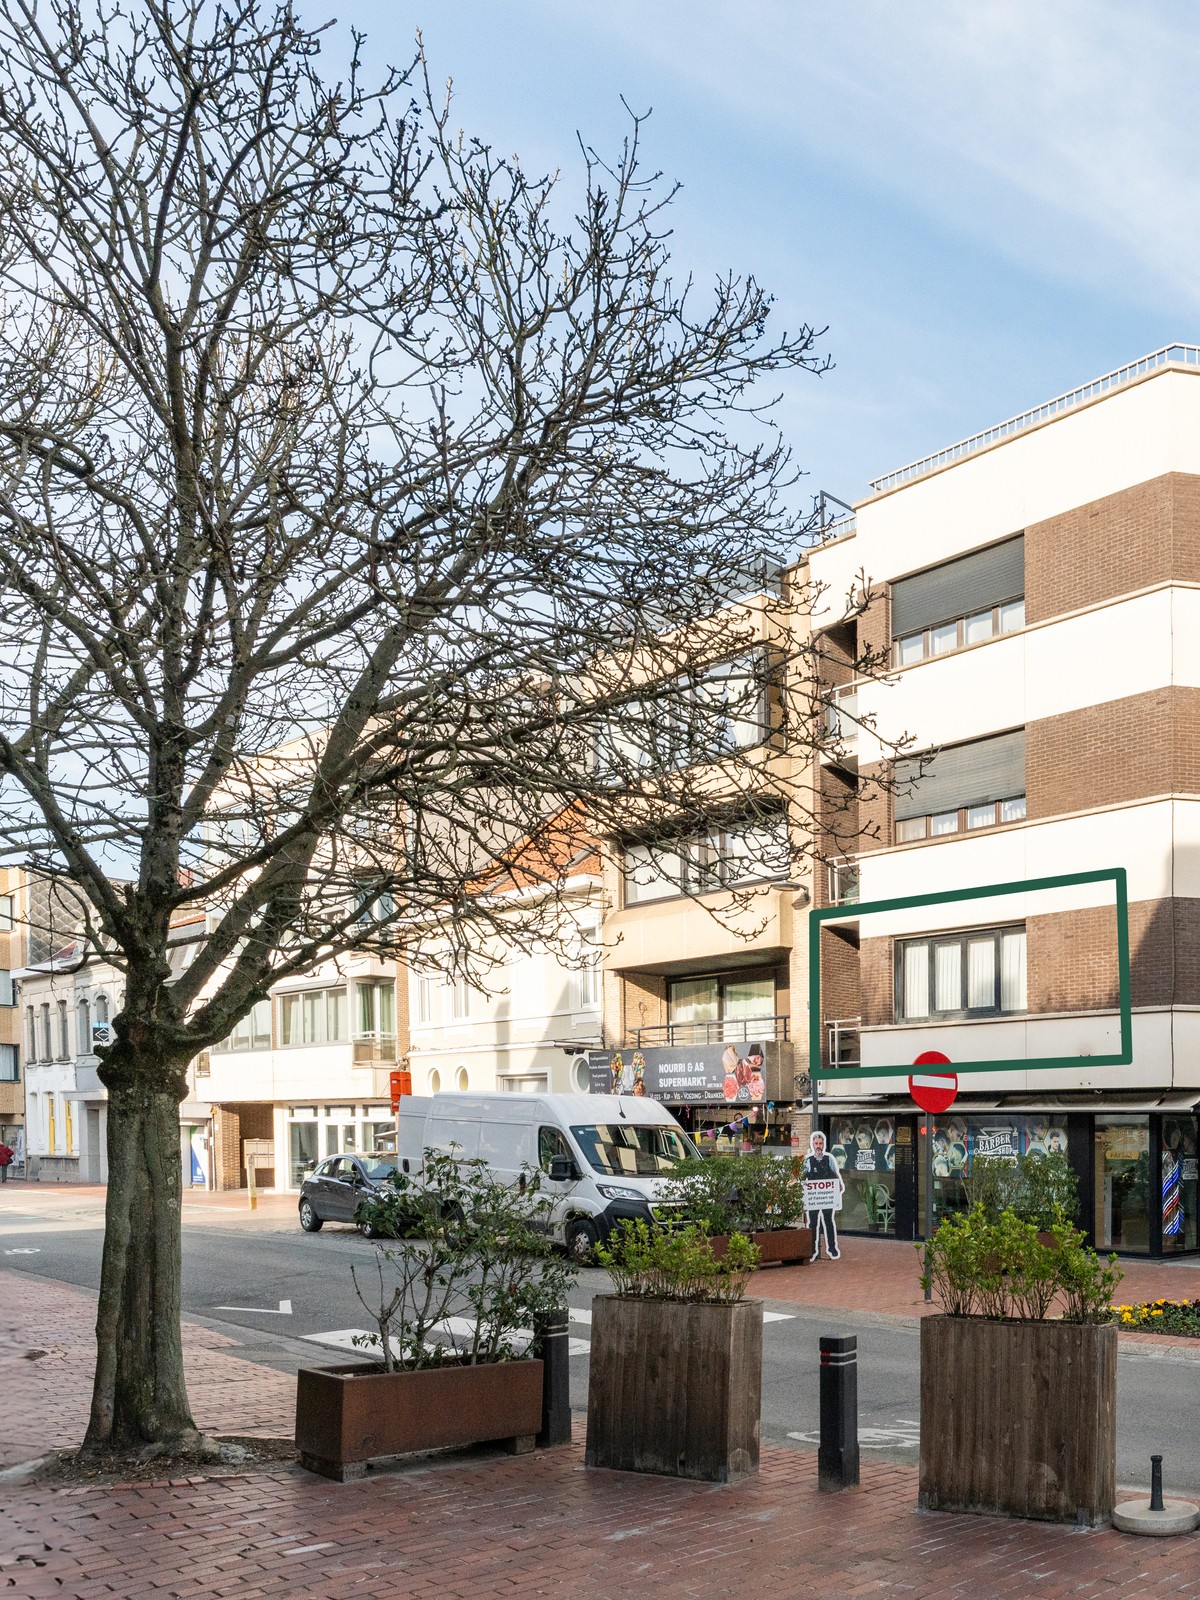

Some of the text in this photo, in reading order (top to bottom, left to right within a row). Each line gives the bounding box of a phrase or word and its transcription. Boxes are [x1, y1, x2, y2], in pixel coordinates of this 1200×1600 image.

[658, 1062, 705, 1073] NOURRI & AS
[658, 1076, 707, 1087] SUPERMARKT
[979, 1133, 1011, 1151] BARBER
[998, 1147, 1014, 1155] SHOP
[807, 1181, 834, 1190] STOP!
